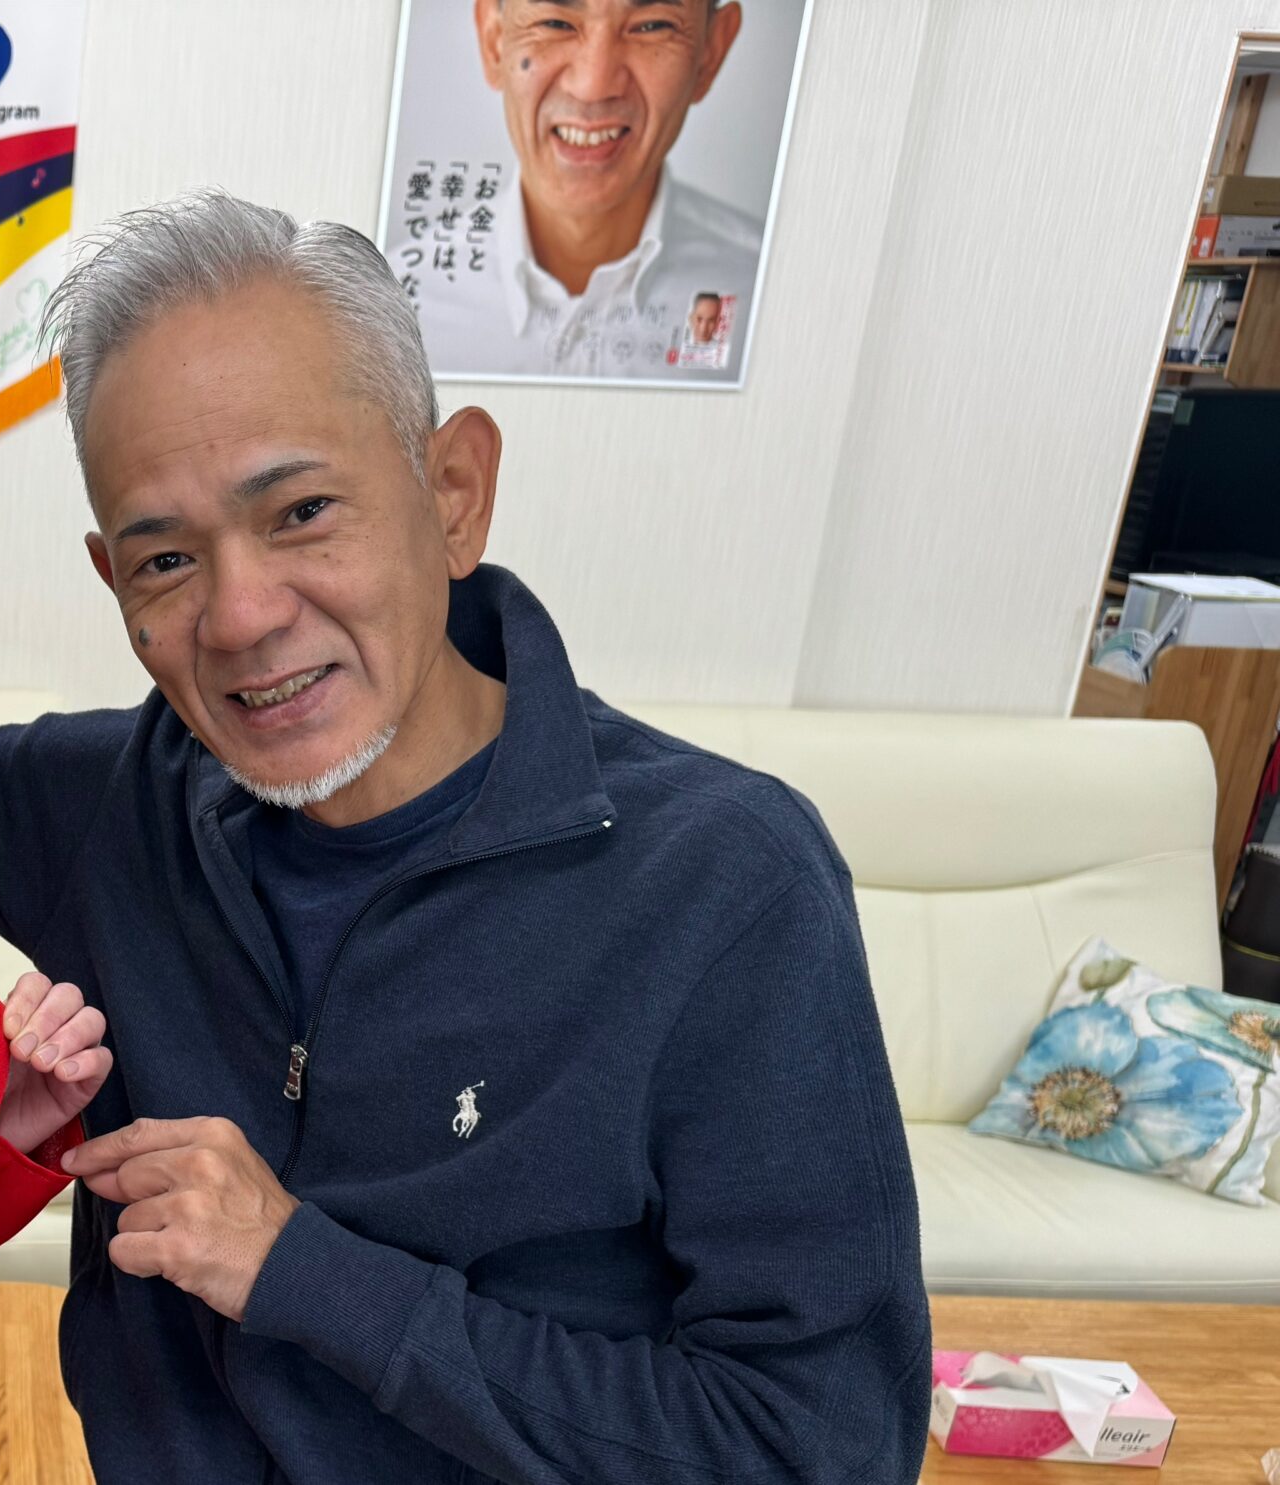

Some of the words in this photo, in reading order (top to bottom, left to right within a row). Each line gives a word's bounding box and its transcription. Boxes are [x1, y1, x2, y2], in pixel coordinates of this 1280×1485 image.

[466, 163, 502, 271] 「お金」と
[1100, 1427, 1151, 1443] lleair
